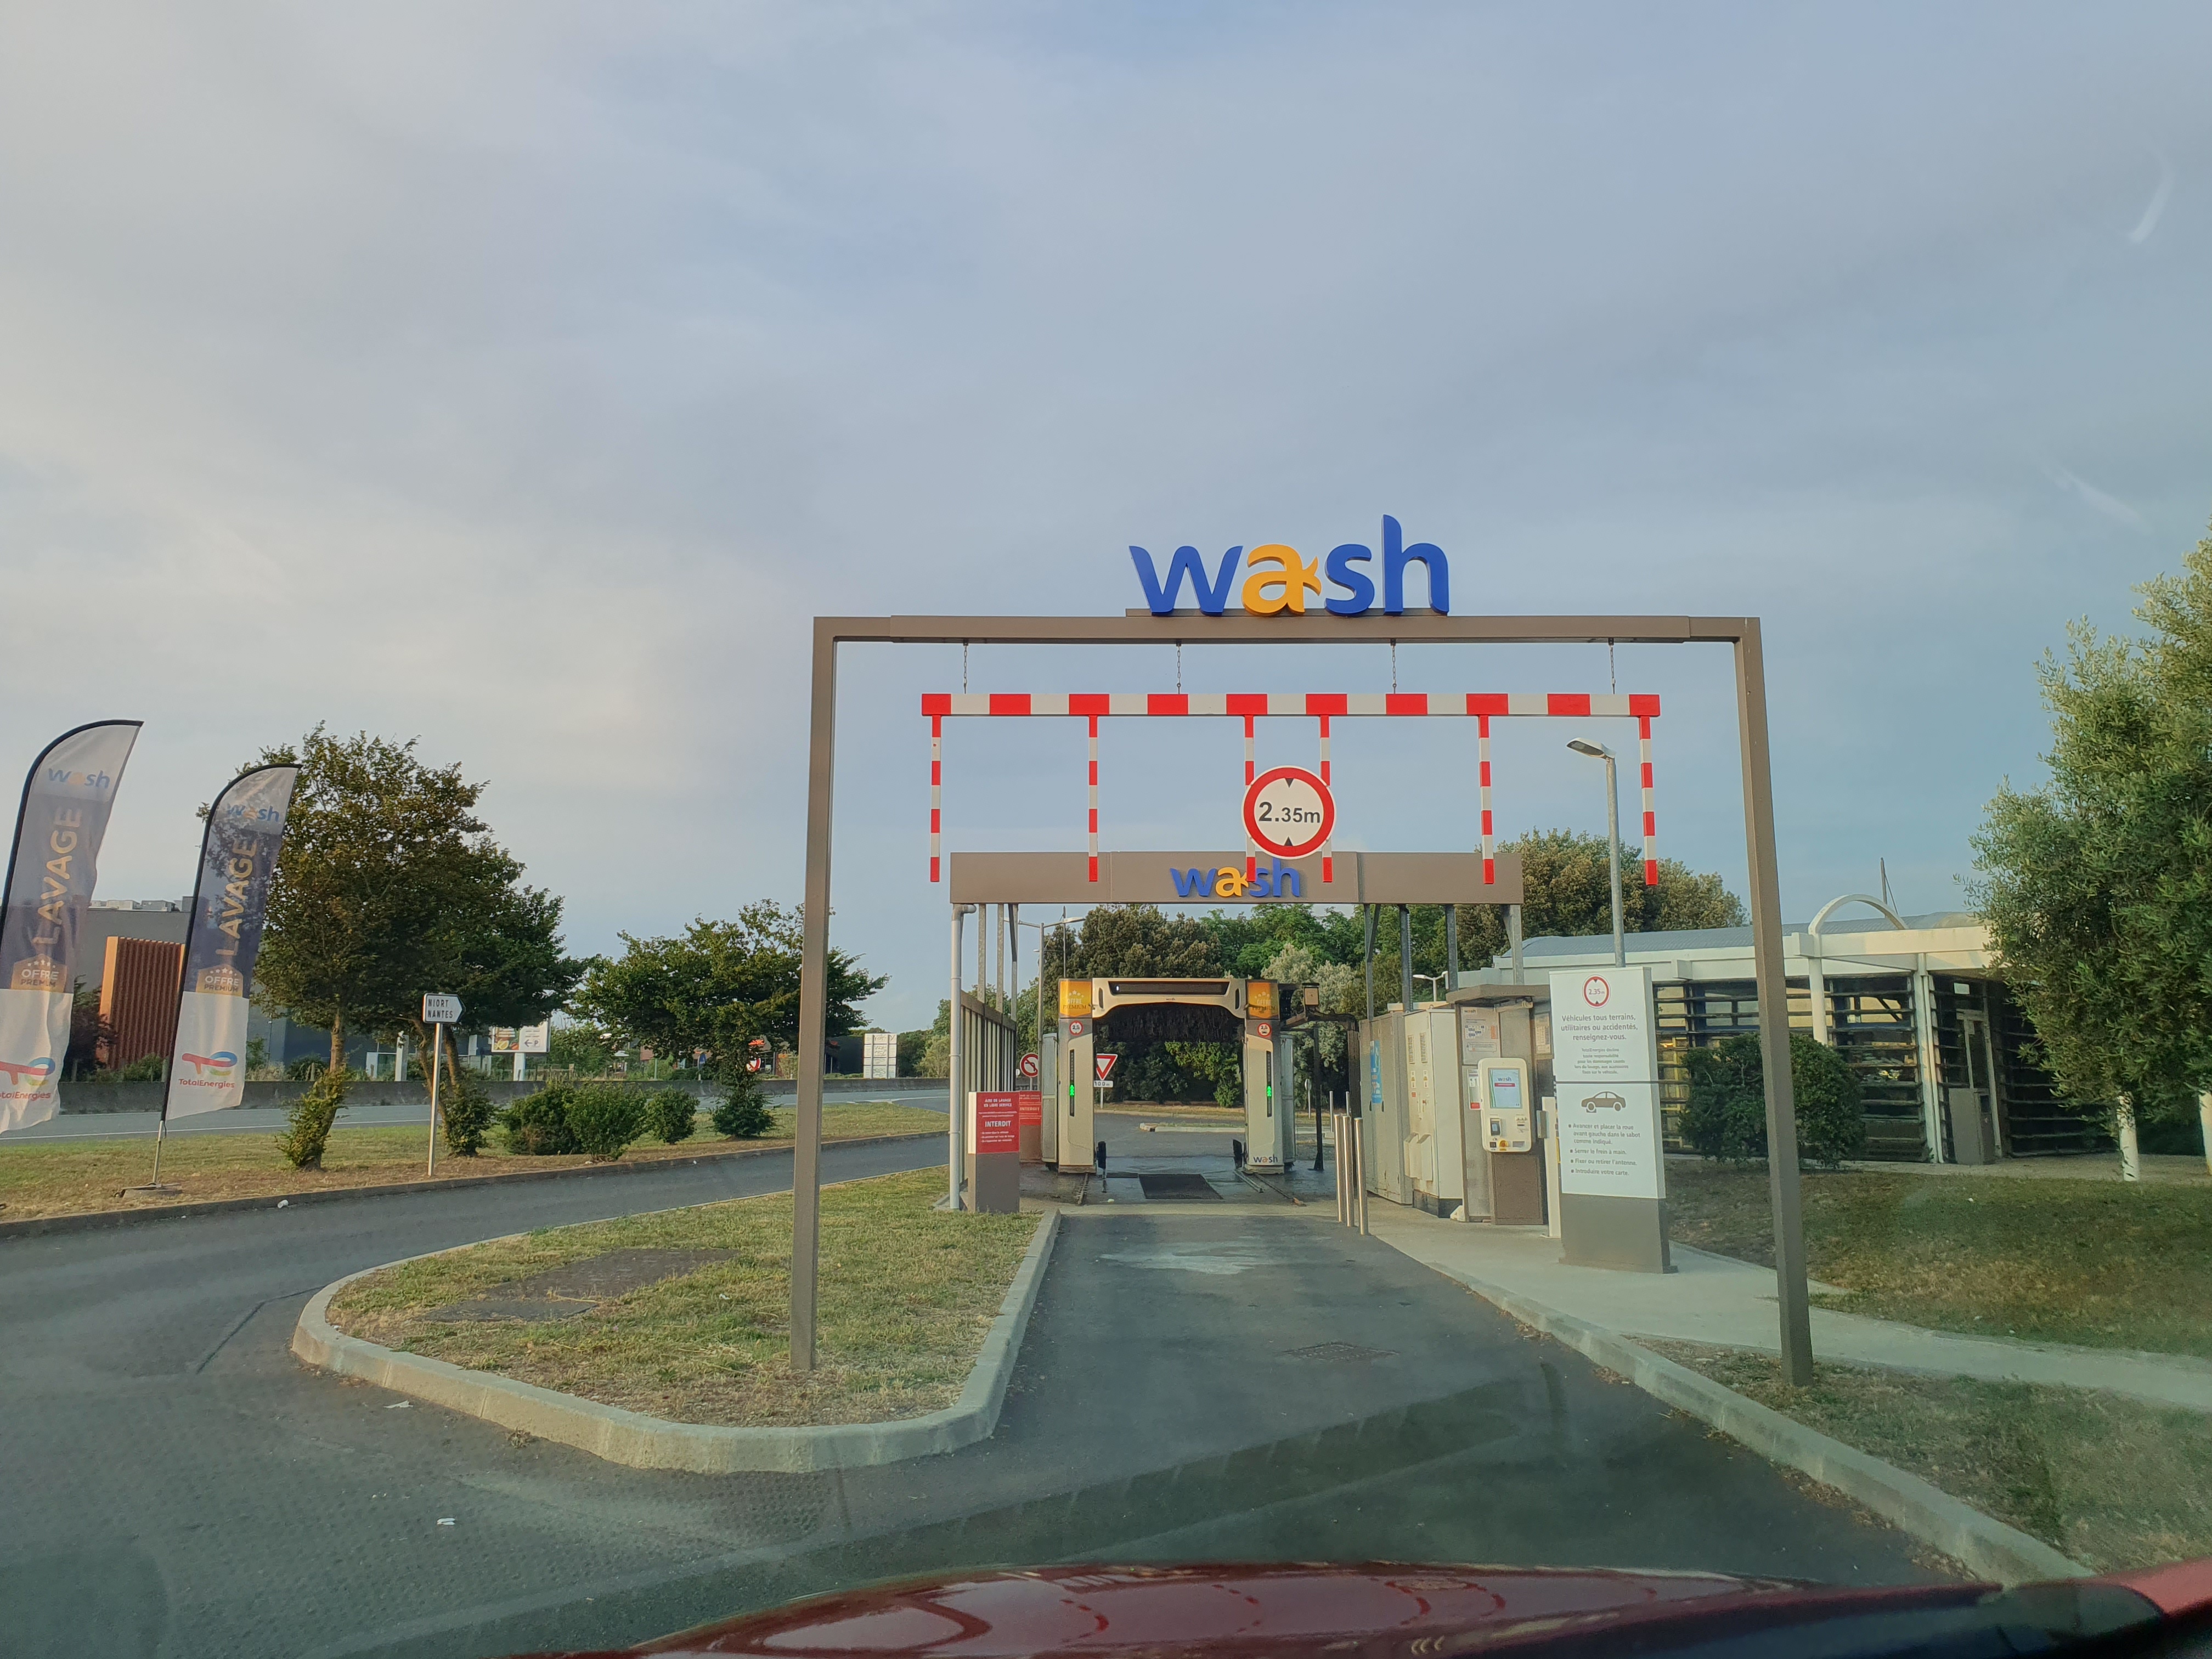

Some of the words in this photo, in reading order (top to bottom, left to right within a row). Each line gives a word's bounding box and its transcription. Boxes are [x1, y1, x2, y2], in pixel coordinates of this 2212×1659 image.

[1128, 514, 1450, 617] wash
[1259, 801, 1321, 823] 2.35m
[33, 807, 83, 945] LAVAGE
[1170, 857, 1300, 897] wash
[216, 837, 258, 956] LAVAGE
[21, 969, 59, 980] OFFRE
[205, 976, 239, 986] OFFRE
[204, 984, 239, 992] PREMIUM
[428, 998, 449, 1007] NIORT
[427, 1010, 453, 1019] NANTES
[1573, 1034, 1627, 1042] renseignez-vous.
[178, 1078, 235, 1089] TotalEnergies
[0, 1091, 52, 1102] talEnergies
[1253, 1154, 1278, 1163] wash
